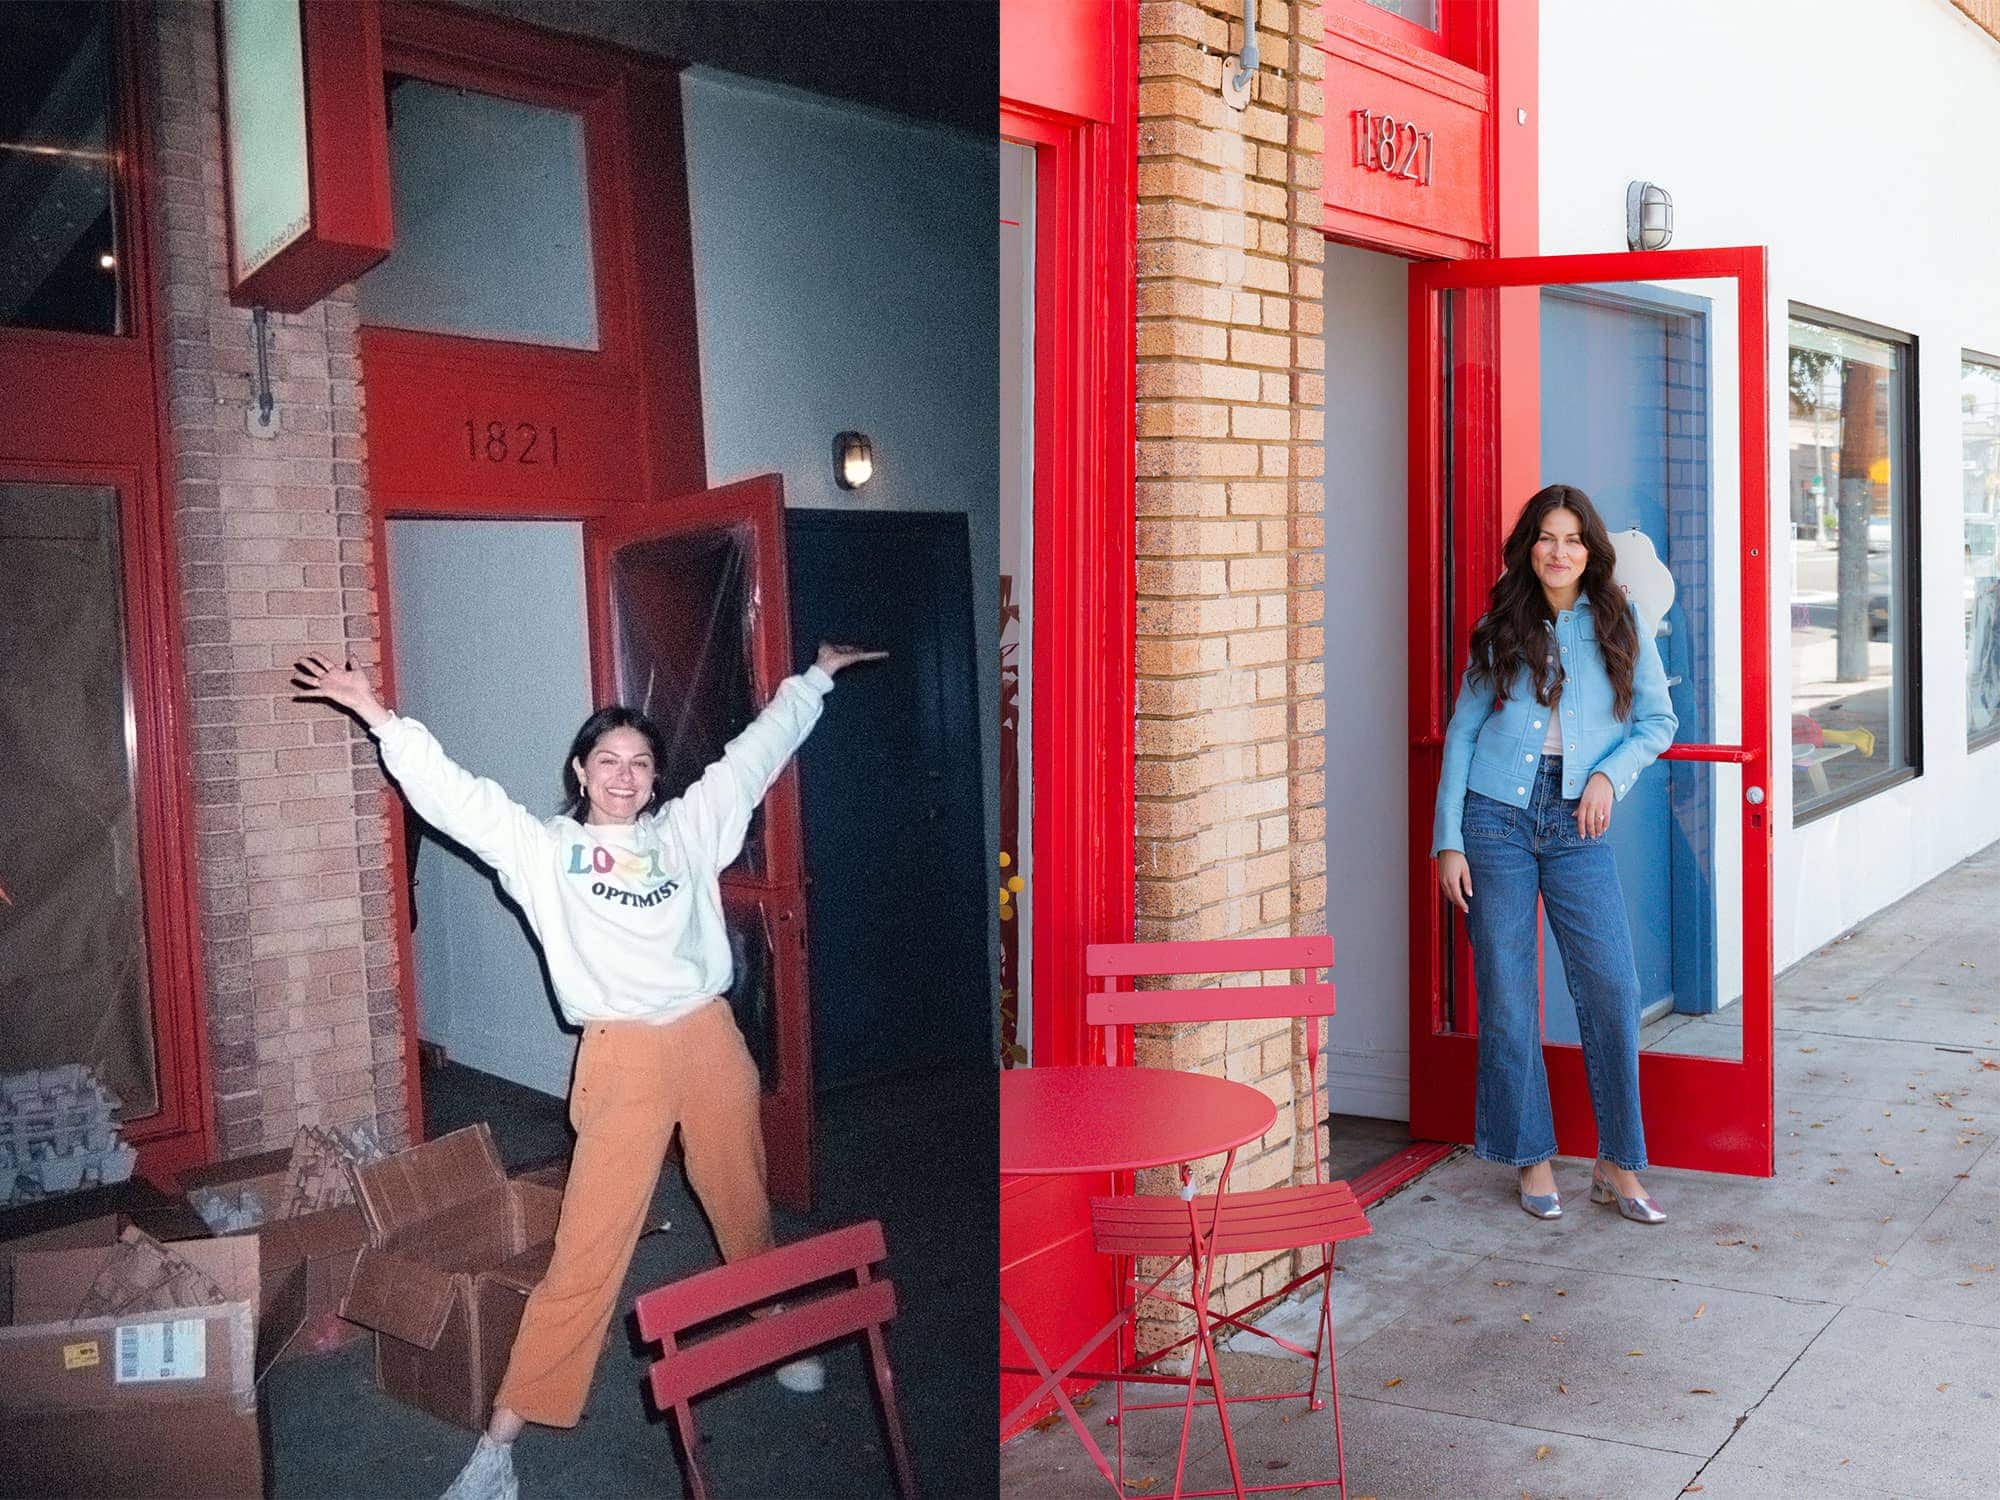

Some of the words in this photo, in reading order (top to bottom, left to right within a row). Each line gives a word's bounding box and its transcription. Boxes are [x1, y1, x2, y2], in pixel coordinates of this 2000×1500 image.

[1357, 108, 1433, 187] 1821
[465, 419, 558, 464] 1821
[591, 879, 680, 908] OPTIMIST
